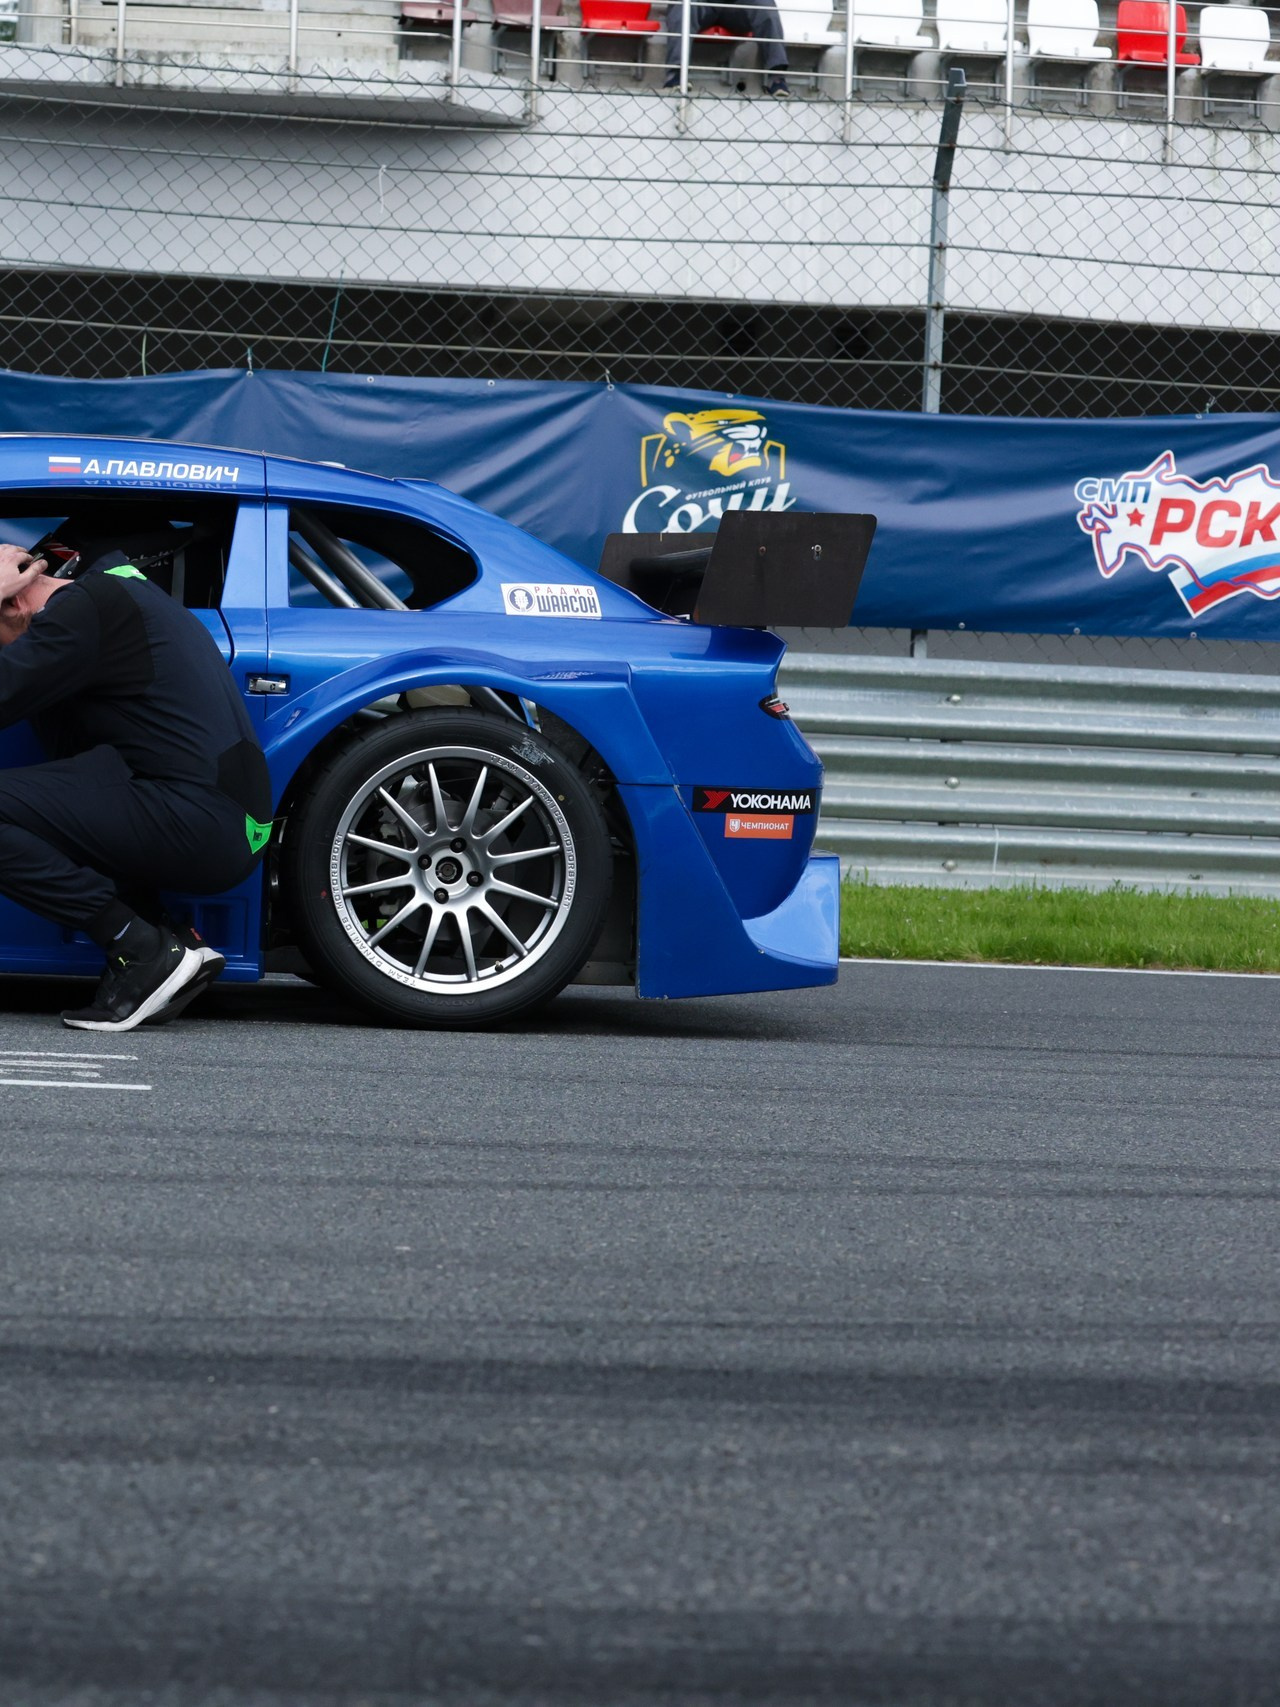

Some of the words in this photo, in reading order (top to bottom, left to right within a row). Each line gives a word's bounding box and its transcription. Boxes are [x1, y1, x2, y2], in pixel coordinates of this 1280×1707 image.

[83, 459, 239, 482] А.ПАВЛОВИЧ
[685, 481, 746, 501] ФУТБОЛЬНЫЙ
[748, 476, 772, 487] КЛУБ
[1076, 479, 1152, 504] СМП
[534, 586, 593, 596] РАДИО
[536, 595, 598, 613] ШАНСОН
[730, 793, 811, 810] YOKOHAMA
[489, 755, 520, 773] TEAM
[522, 775, 564, 824] DYNAMICS
[561, 831, 576, 910] MOTORSPORT
[741, 822, 790, 830] ЧЕМПИОНАТ
[330, 831, 345, 910] MOTORSPORT
